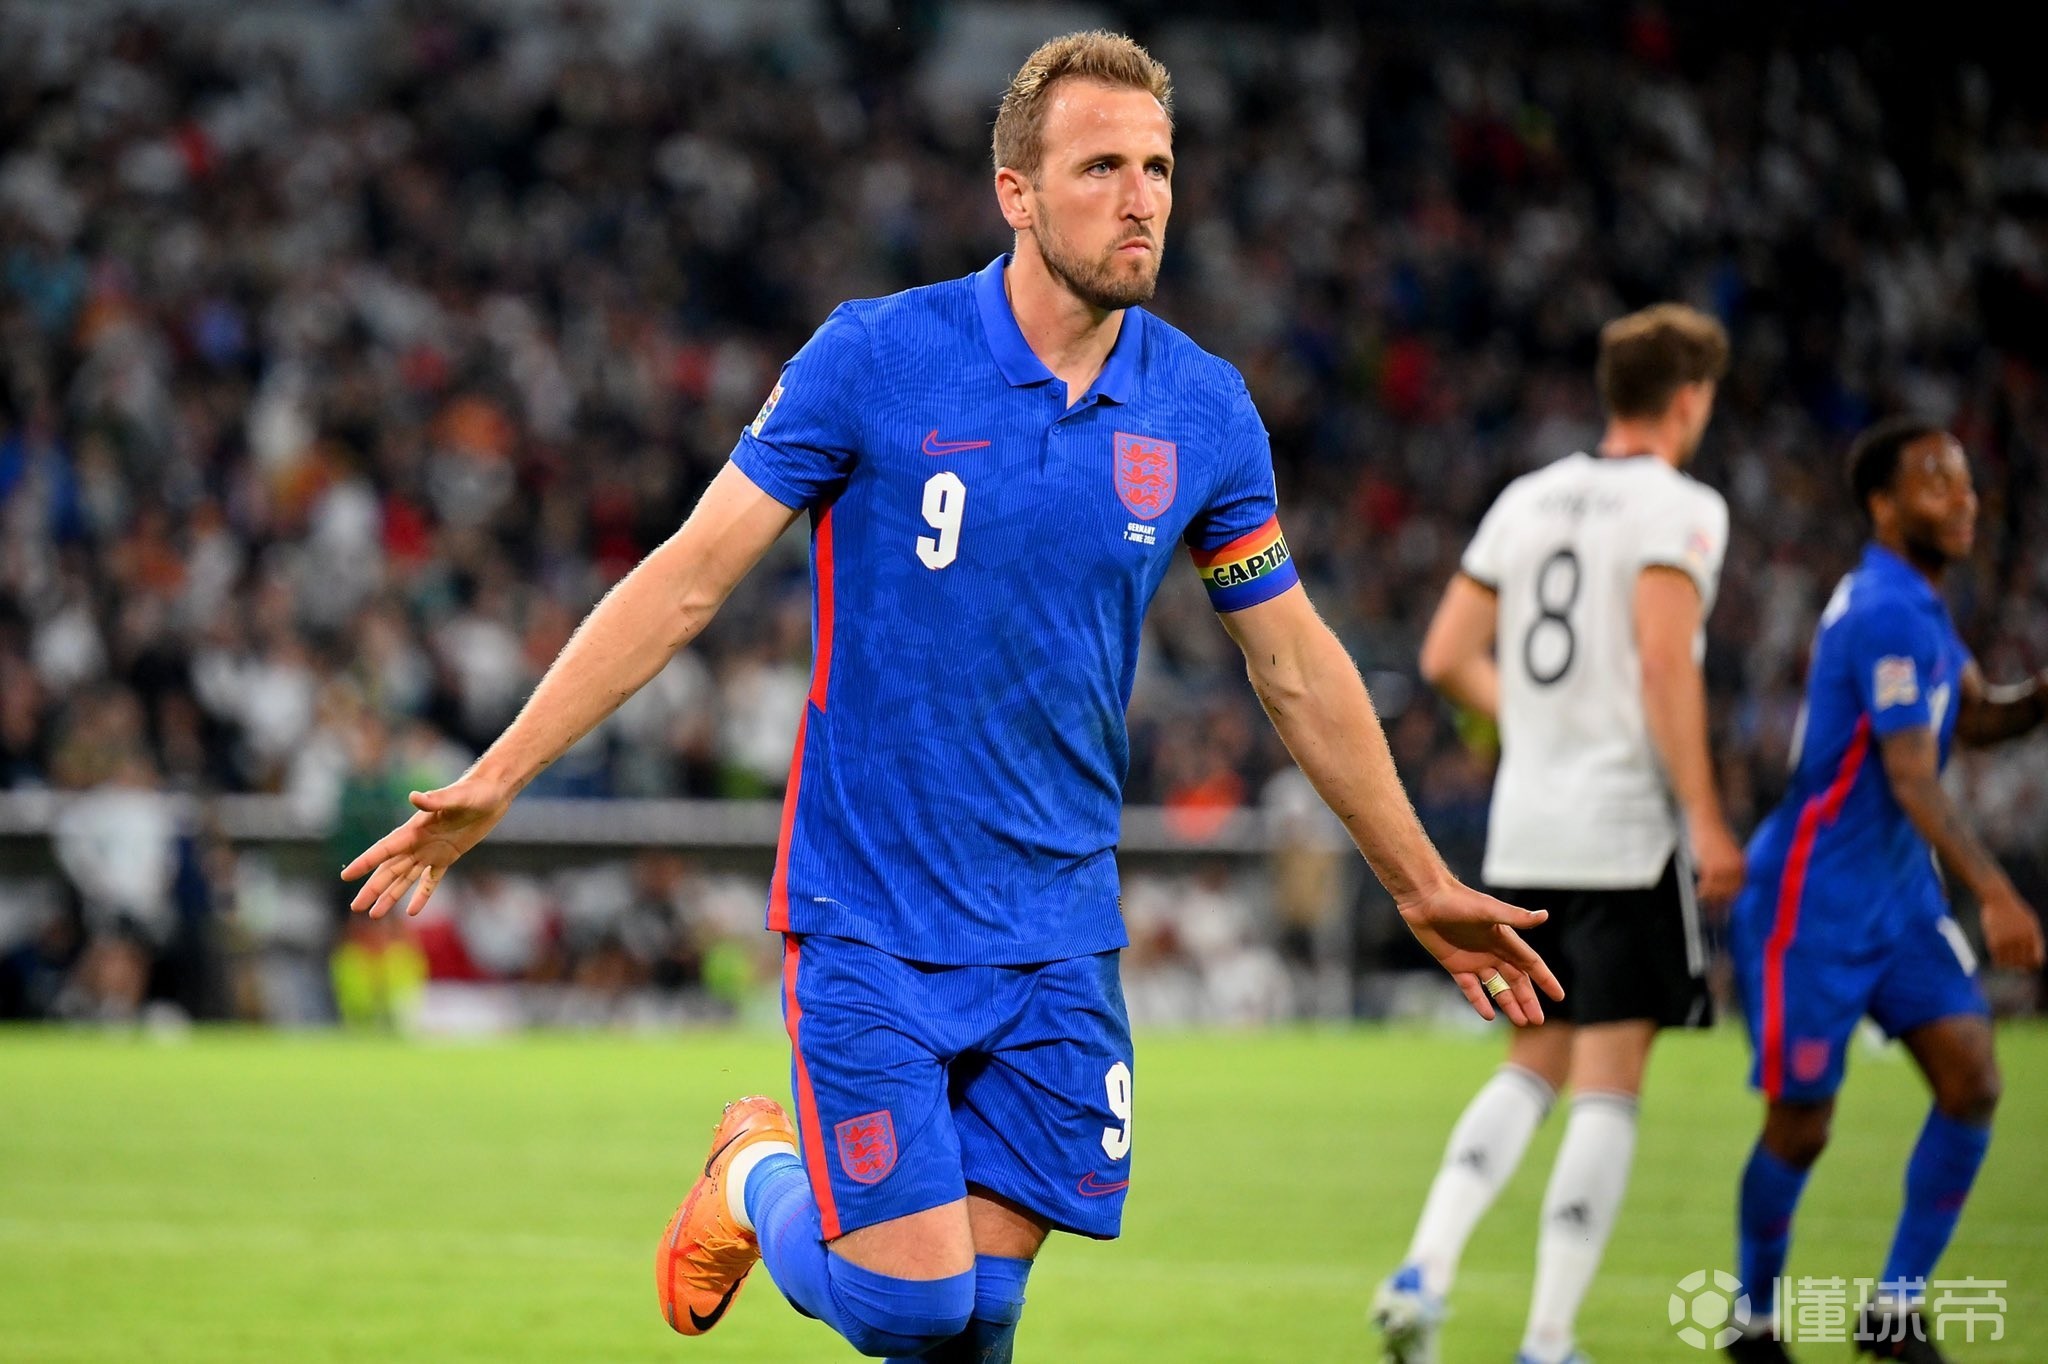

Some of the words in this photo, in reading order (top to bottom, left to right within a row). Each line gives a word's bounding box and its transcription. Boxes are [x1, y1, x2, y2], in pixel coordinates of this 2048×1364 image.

[916, 471, 966, 570] 9
[1123, 531, 1129, 540] 7
[1128, 533, 1144, 543] JUNE
[1127, 522, 1156, 536] GERMANY
[1522, 546, 1581, 688] 8
[1101, 1061, 1132, 1161] 9
